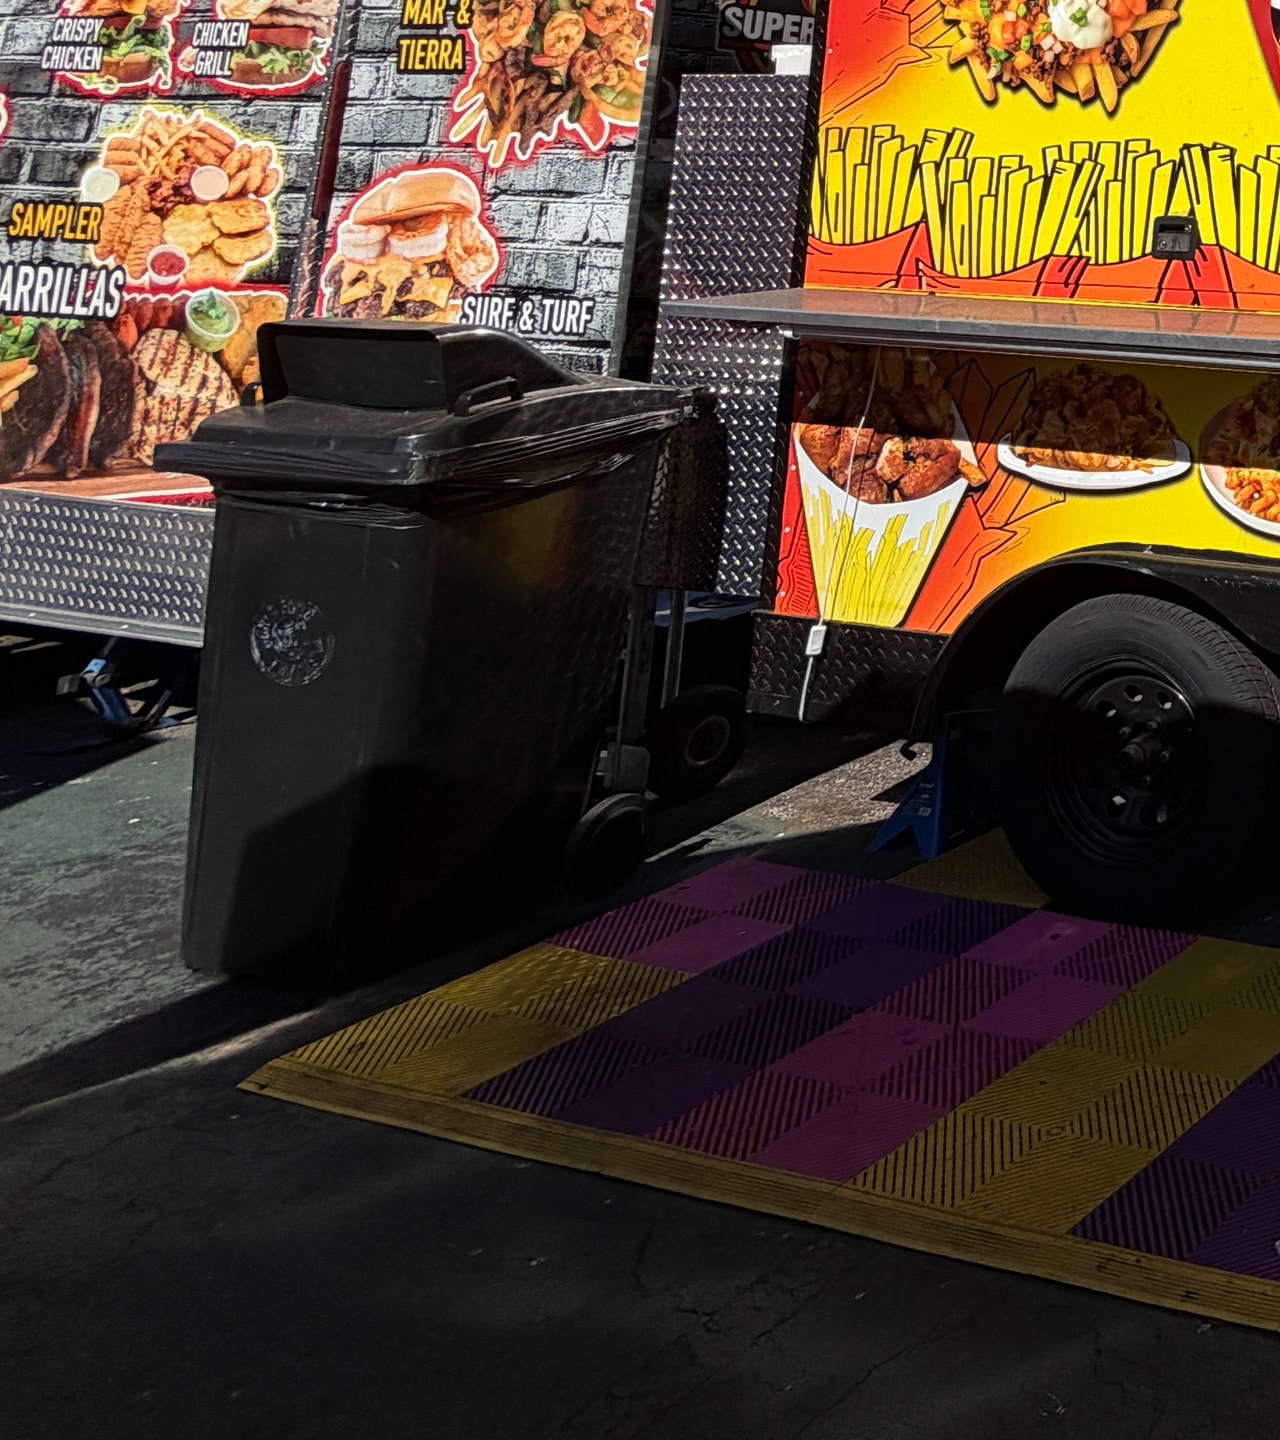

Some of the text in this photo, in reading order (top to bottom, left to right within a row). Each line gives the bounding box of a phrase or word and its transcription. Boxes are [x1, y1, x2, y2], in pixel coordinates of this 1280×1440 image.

[52, 19, 104, 43] CRISPY
[192, 22, 249, 47] CHICKEN
[41, 47, 104, 71] CHICKEN
[194, 51, 233, 75] GRILL
[399, 39, 464, 70] TIERRA
[8, 203, 102, 241] SAMPLER
[461, 296, 594, 334] SURF & TURF
